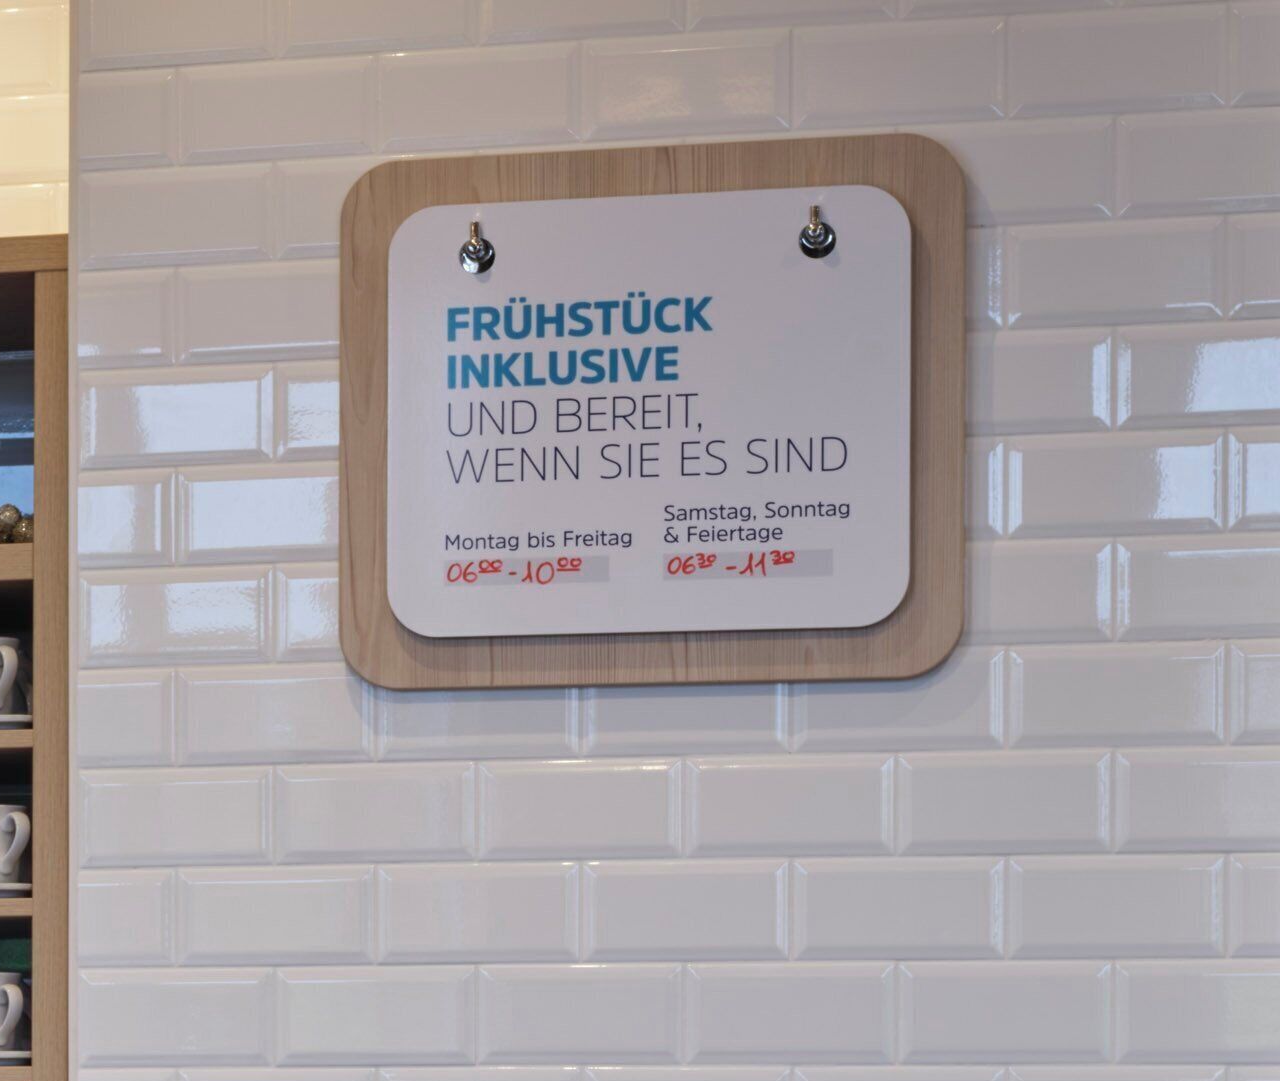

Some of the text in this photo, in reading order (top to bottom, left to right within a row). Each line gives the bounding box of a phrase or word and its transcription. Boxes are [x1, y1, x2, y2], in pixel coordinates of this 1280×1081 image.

[446, 291, 713, 342] FRÜHSTÜCK
[446, 346, 679, 390] INKLUSIVE
[447, 393, 703, 437] UND BEREIT,
[446, 436, 848, 484] WENN SIE ES SIND
[663, 501, 850, 521] Samstag, Sonntag
[445, 530, 633, 551] Montag bis Freitag
[663, 525, 783, 544] & Feiertage
